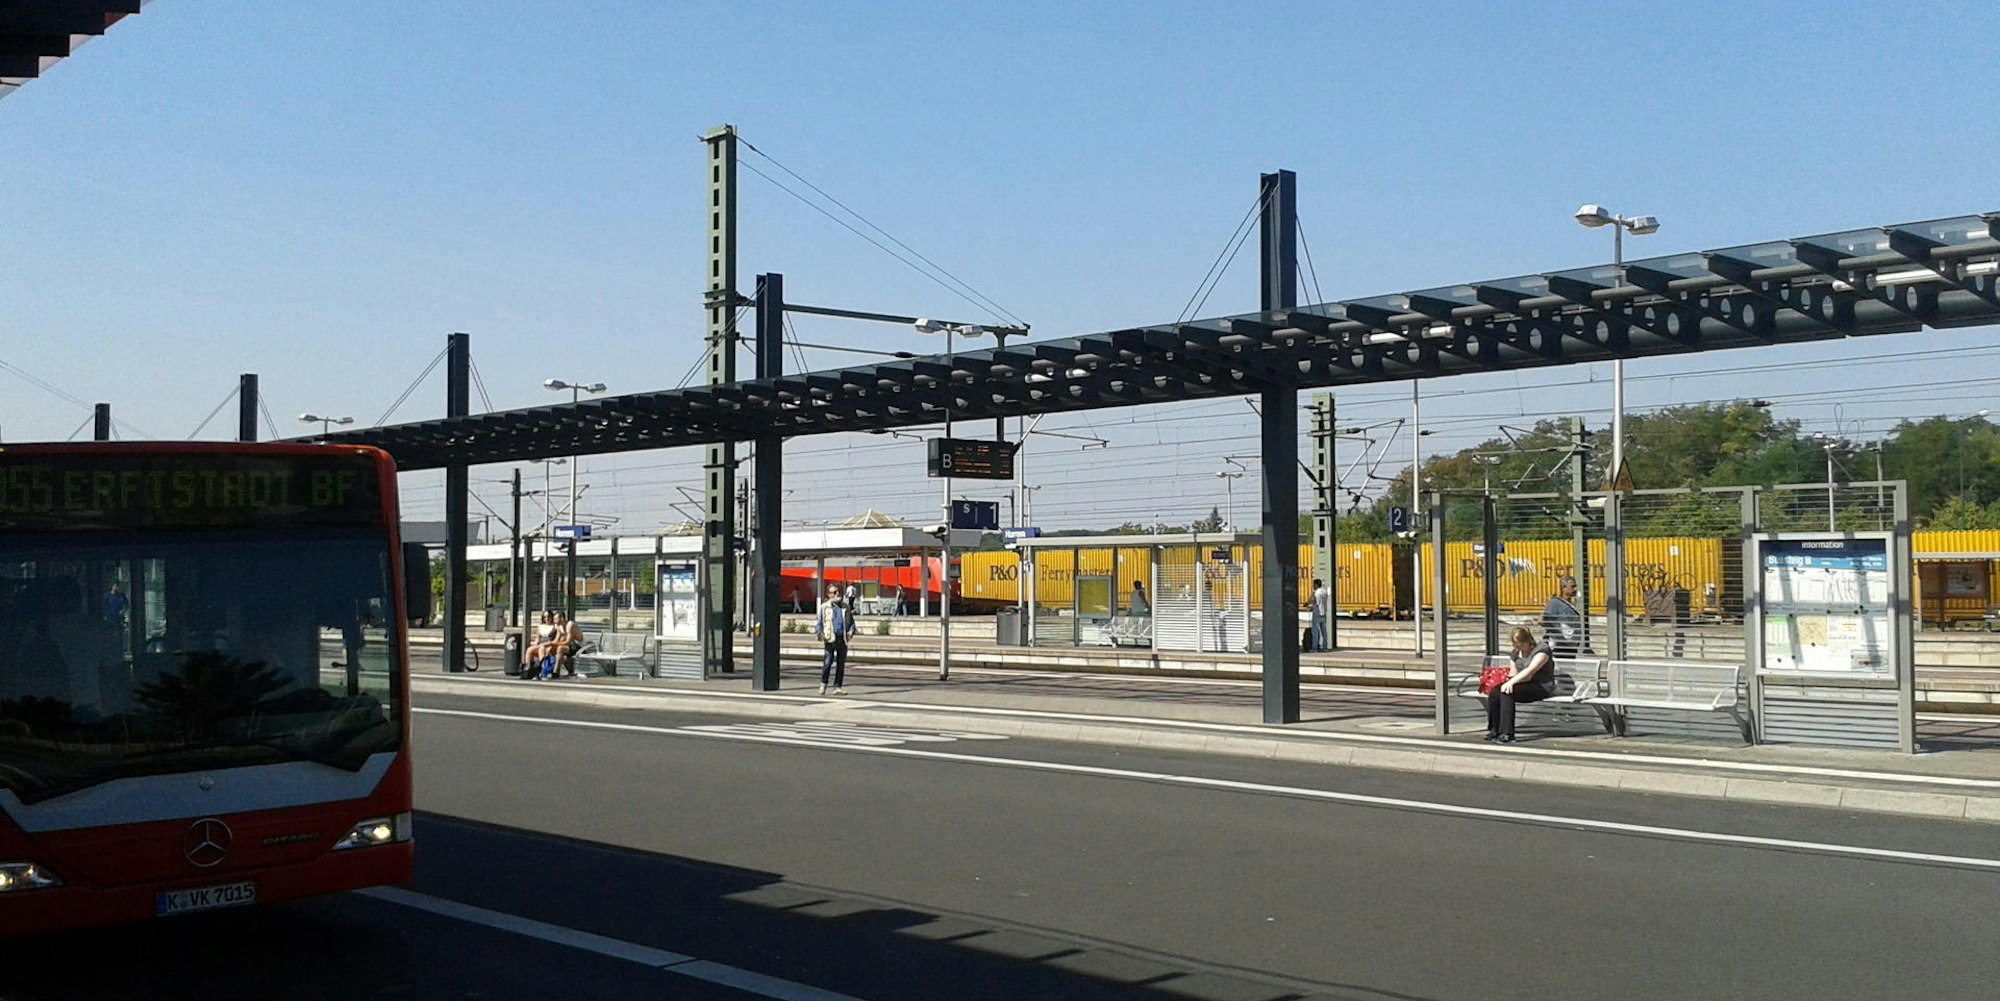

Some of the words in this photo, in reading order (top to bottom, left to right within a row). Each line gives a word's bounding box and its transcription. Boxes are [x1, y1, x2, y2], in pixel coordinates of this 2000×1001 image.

[942, 453, 952, 469] B
[311, 469, 358, 507] BF
[963, 503, 970, 514] S
[989, 503, 997, 524] 1
[1393, 508, 1402, 526] 2
[989, 565, 1018, 581] P&O
[166, 894, 178, 911] K
[189, 890, 211, 908] VK
[213, 885, 254, 904] 7015
